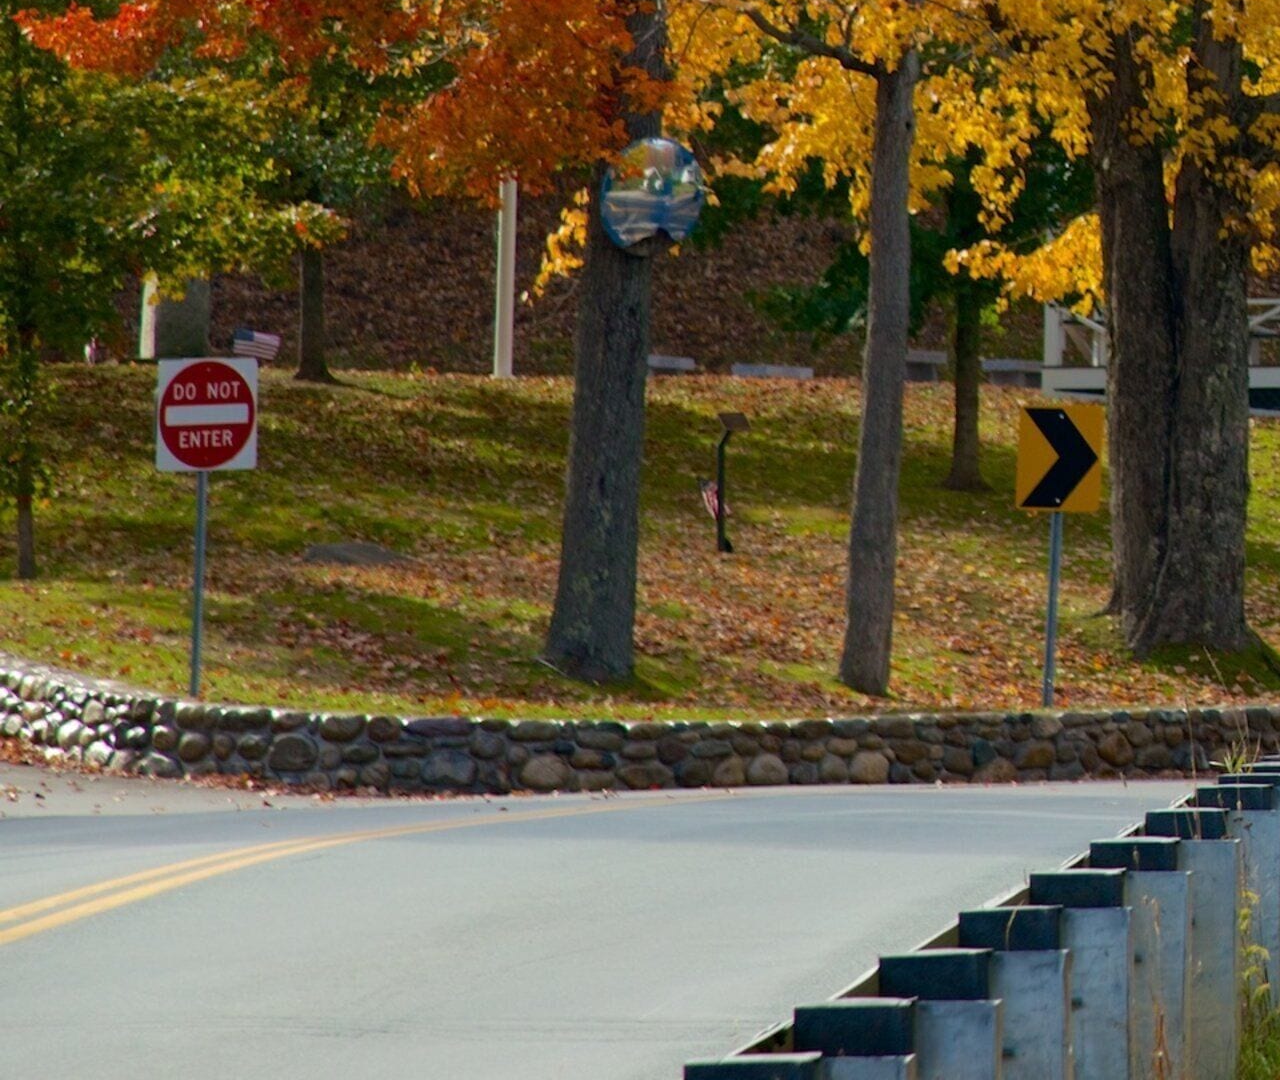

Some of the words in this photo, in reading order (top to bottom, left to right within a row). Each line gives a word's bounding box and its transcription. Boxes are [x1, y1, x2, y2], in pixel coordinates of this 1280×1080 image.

[173, 383, 196, 400] DO
[207, 381, 240, 399] NOT
[179, 430, 233, 449] ENTER
